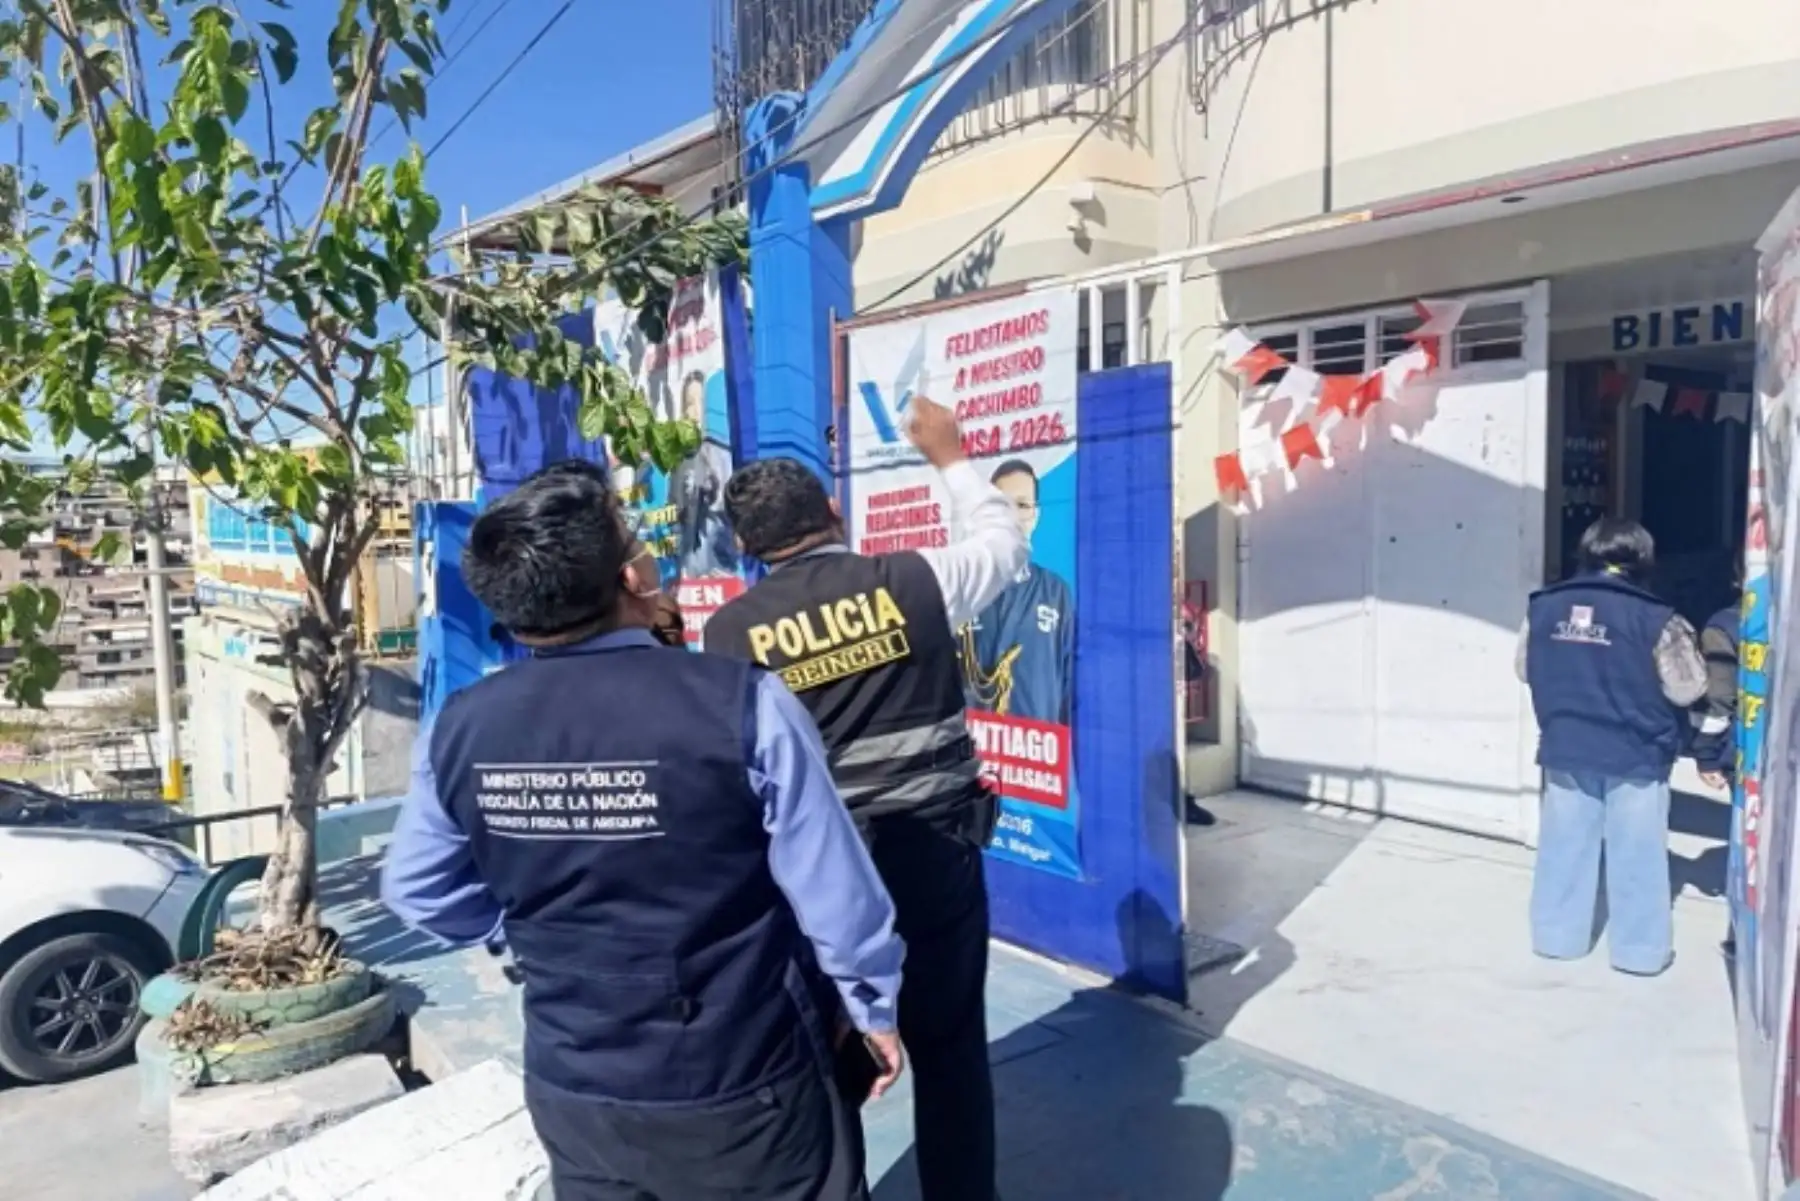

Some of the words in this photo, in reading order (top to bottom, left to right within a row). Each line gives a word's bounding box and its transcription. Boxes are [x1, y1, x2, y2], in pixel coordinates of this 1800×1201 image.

[945, 309, 1049, 361] FELICITAMOS
[1612, 302, 1743, 350] BIEN
[953, 368, 966, 391] A
[970, 346, 1045, 388] NUESTRO
[954, 381, 1042, 422] CACHIMBO
[960, 426, 1001, 458] NSA
[1009, 412, 1066, 450] 2026
[866, 503, 941, 534] RELACIONES
[966, 719, 1058, 769] NTIAGO
[482, 772, 568, 789] MINISTERIO
[572, 765, 645, 788] PÚBLICO
[544, 794, 564, 810] DE
[568, 794, 589, 810] LA
[593, 789, 658, 810] NACIÓN
